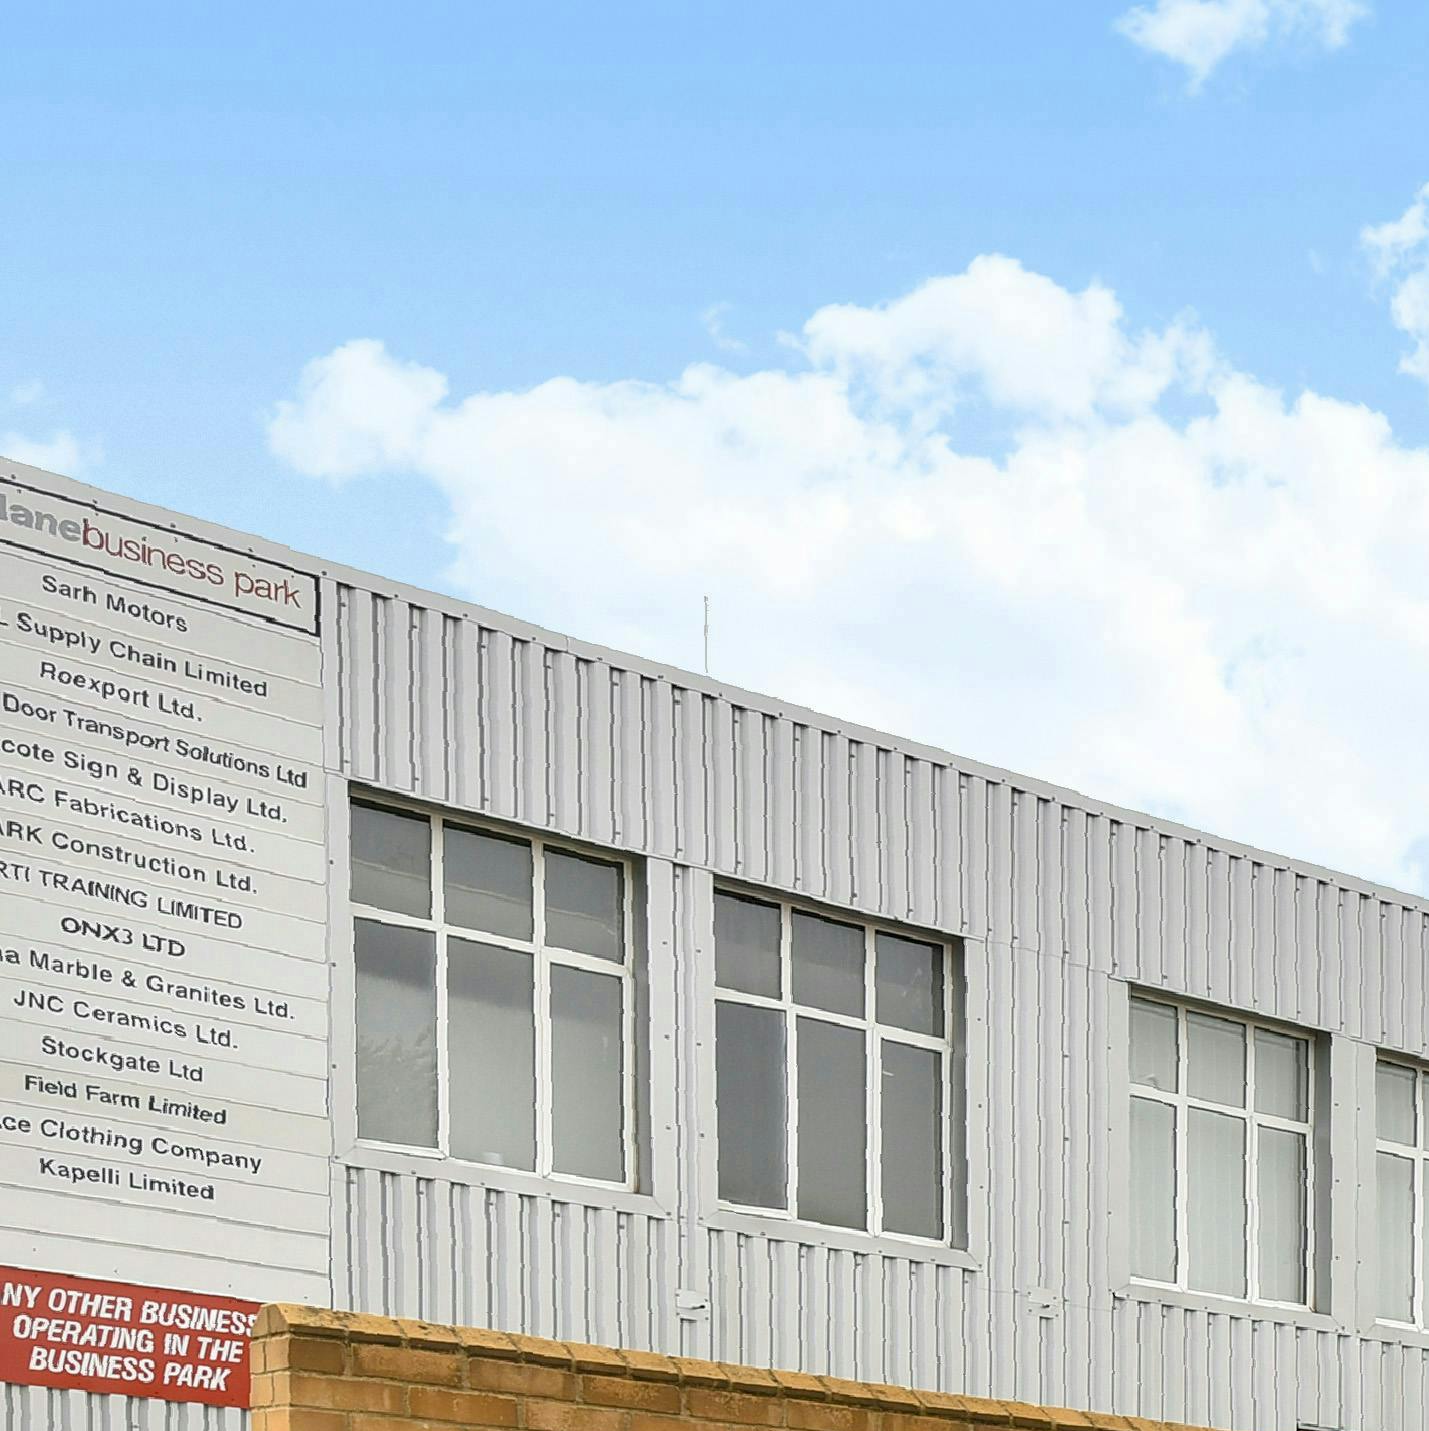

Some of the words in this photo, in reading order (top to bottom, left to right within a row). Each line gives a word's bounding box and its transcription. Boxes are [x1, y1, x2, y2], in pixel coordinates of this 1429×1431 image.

[42, 574, 96, 604] Sarh
[106, 594, 188, 632] Motors
[235, 571, 302, 608] park
[17, 612, 101, 653] Supply
[110, 640, 177, 672] Chain
[185, 661, 268, 697] Limited
[40, 662, 149, 708] Roexport
[2, 693, 57, 724] Door
[63, 709, 169, 752] Transport
[176, 739, 270, 778] Solutions
[277, 765, 308, 789] Ltd
[64, 751, 118, 779] Sign
[127, 768, 143, 786] &
[153, 774, 238, 813] Display
[54, 790, 202, 841] Fabrications
[211, 829, 255, 853] Ltd.
[0, 821, 43, 845] RK
[52, 832, 206, 882] Construction
[216, 870, 258, 894] Ltd.
[39, 870, 148, 909] TRAINING
[158, 898, 243, 929] LIMITED
[60, 917, 133, 944] ONX3
[142, 934, 186, 957] LTD
[30, 950, 113, 983] Marble
[121, 970, 137, 988] &
[146, 975, 246, 1011] Granites
[254, 997, 295, 1020] Ltd.
[13, 990, 64, 1013] JNC
[73, 1001, 187, 1037] Ceramics
[196, 1024, 238, 1049] Ltd.
[42, 1035, 160, 1073] Stockgate
[169, 1059, 204, 1083] Ltd
[24, 1074, 77, 1099] Field
[86, 1085, 140, 1109] Farm
[148, 1095, 227, 1125] Limited
[40, 1119, 143, 1155] Clothing
[152, 1138, 262, 1174] Company
[39, 1157, 120, 1185] Kapelli
[129, 1172, 215, 1200] Limited
[2, 1283, 42, 1308] NY
[48, 1288, 132, 1322] OTHER
[13, 1315, 154, 1353] OPERATING
[163, 1333, 190, 1356] IN
[197, 1337, 244, 1363] THE
[29, 1347, 155, 1383] BUSINESS
[163, 1362, 231, 1391] PARK
